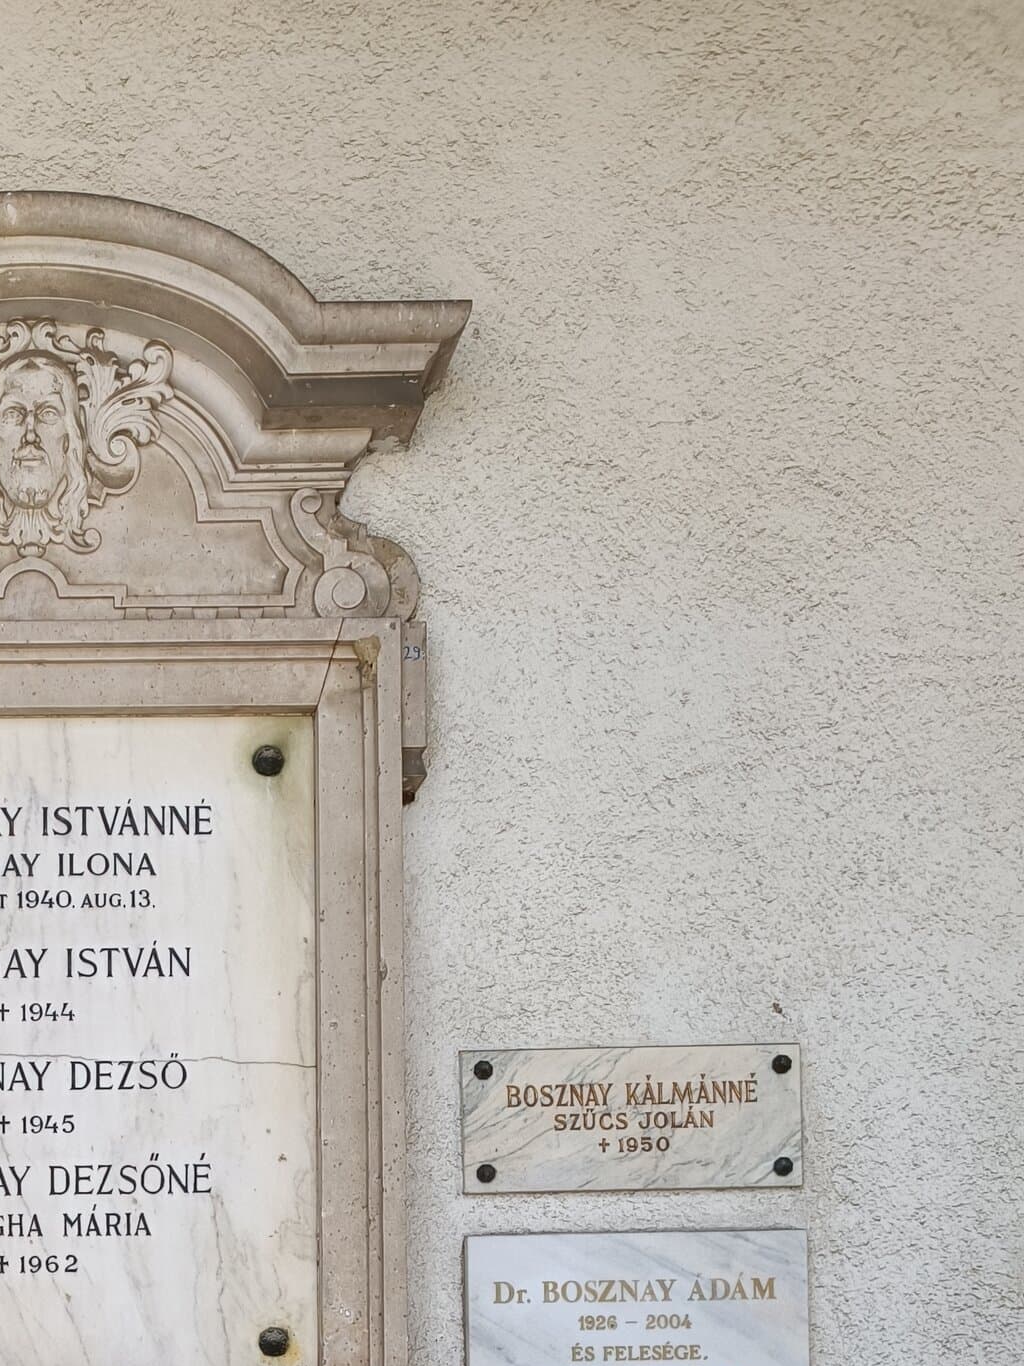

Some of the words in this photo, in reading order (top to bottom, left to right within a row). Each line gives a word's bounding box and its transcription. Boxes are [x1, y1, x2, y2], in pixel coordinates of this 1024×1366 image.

[41, 798, 213, 837] ISTVÁNNÉ
[58, 853, 157, 878] ILONA
[17, 890, 76, 910] 1940.
[65, 939, 192, 978] ISTVÁN
[20, 1003, 76, 1022] 1944
[70, 1053, 188, 1091] DEZSŐ
[507, 1083, 612, 1107] BOSZNAY
[626, 1073, 758, 1105] KÁLMÁNNÉ
[21, 1116, 75, 1135] 1945
[554, 1109, 627, 1130] SZŰCS
[639, 1106, 714, 1129] JOLÁN
[619, 1137, 670, 1152] 1950
[49, 1153, 212, 1195] DEZSŐNÉ
[63, 1205, 152, 1236] MÁRIA
[20, 1255, 79, 1274] 1962
[493, 1281, 531, 1304] Dr.
[542, 1279, 677, 1303] BOSZNAY
[688, 1273, 776, 1301] ÁDÁM
[578, 1315, 618, 1330] 1926
[646, 1314, 692, 1330] 2004
[572, 1342, 594, 1362] ÉS
